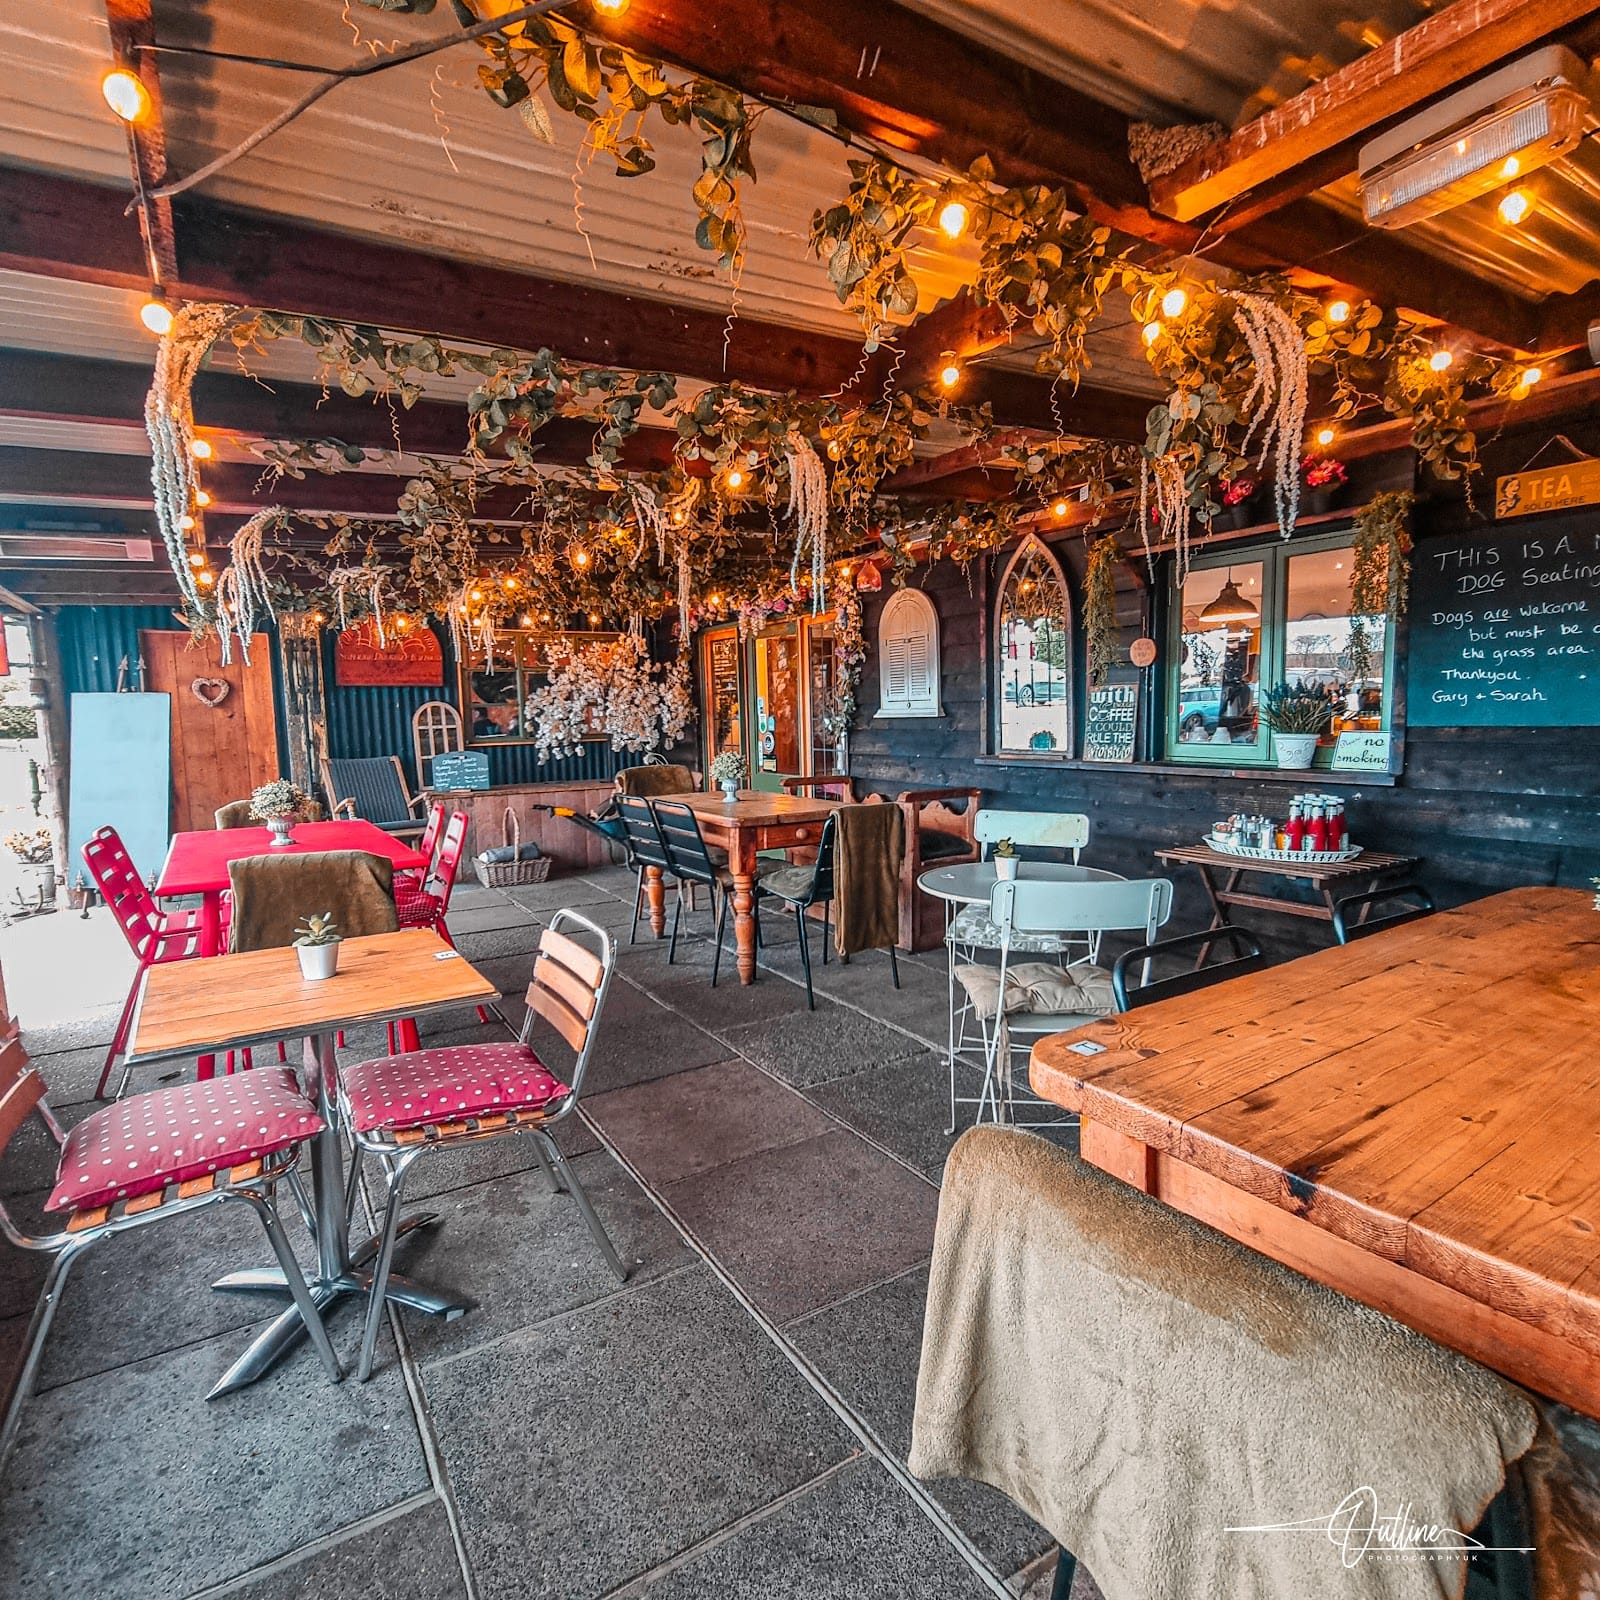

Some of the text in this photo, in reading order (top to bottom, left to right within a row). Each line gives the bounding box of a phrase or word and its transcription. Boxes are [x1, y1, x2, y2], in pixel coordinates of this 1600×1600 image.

[1528, 474, 1573, 500] TEA
[1523, 495, 1585, 512] SOLD HERE
[1523, 540, 1544, 559] IS
[1554, 535, 1576, 554] A
[1457, 571, 1506, 594] DOG
[1432, 610, 1474, 630] Dogs
[1483, 608, 1513, 621] are
[1469, 626, 1497, 642] but
[1505, 625, 1546, 639] must
[1560, 623, 1583, 635] be
[1462, 647, 1486, 659] the
[1492, 647, 1536, 667] grass
[1090, 685, 1135, 704] with
[1431, 689, 1468, 707] Gary
[1489, 687, 1548, 702] Sarah
[1095, 722, 1133, 732] COULD
[1086, 732, 1132, 743] RULE THE
[1363, 738, 1385, 747] no
[1336, 749, 1390, 770] smoking
